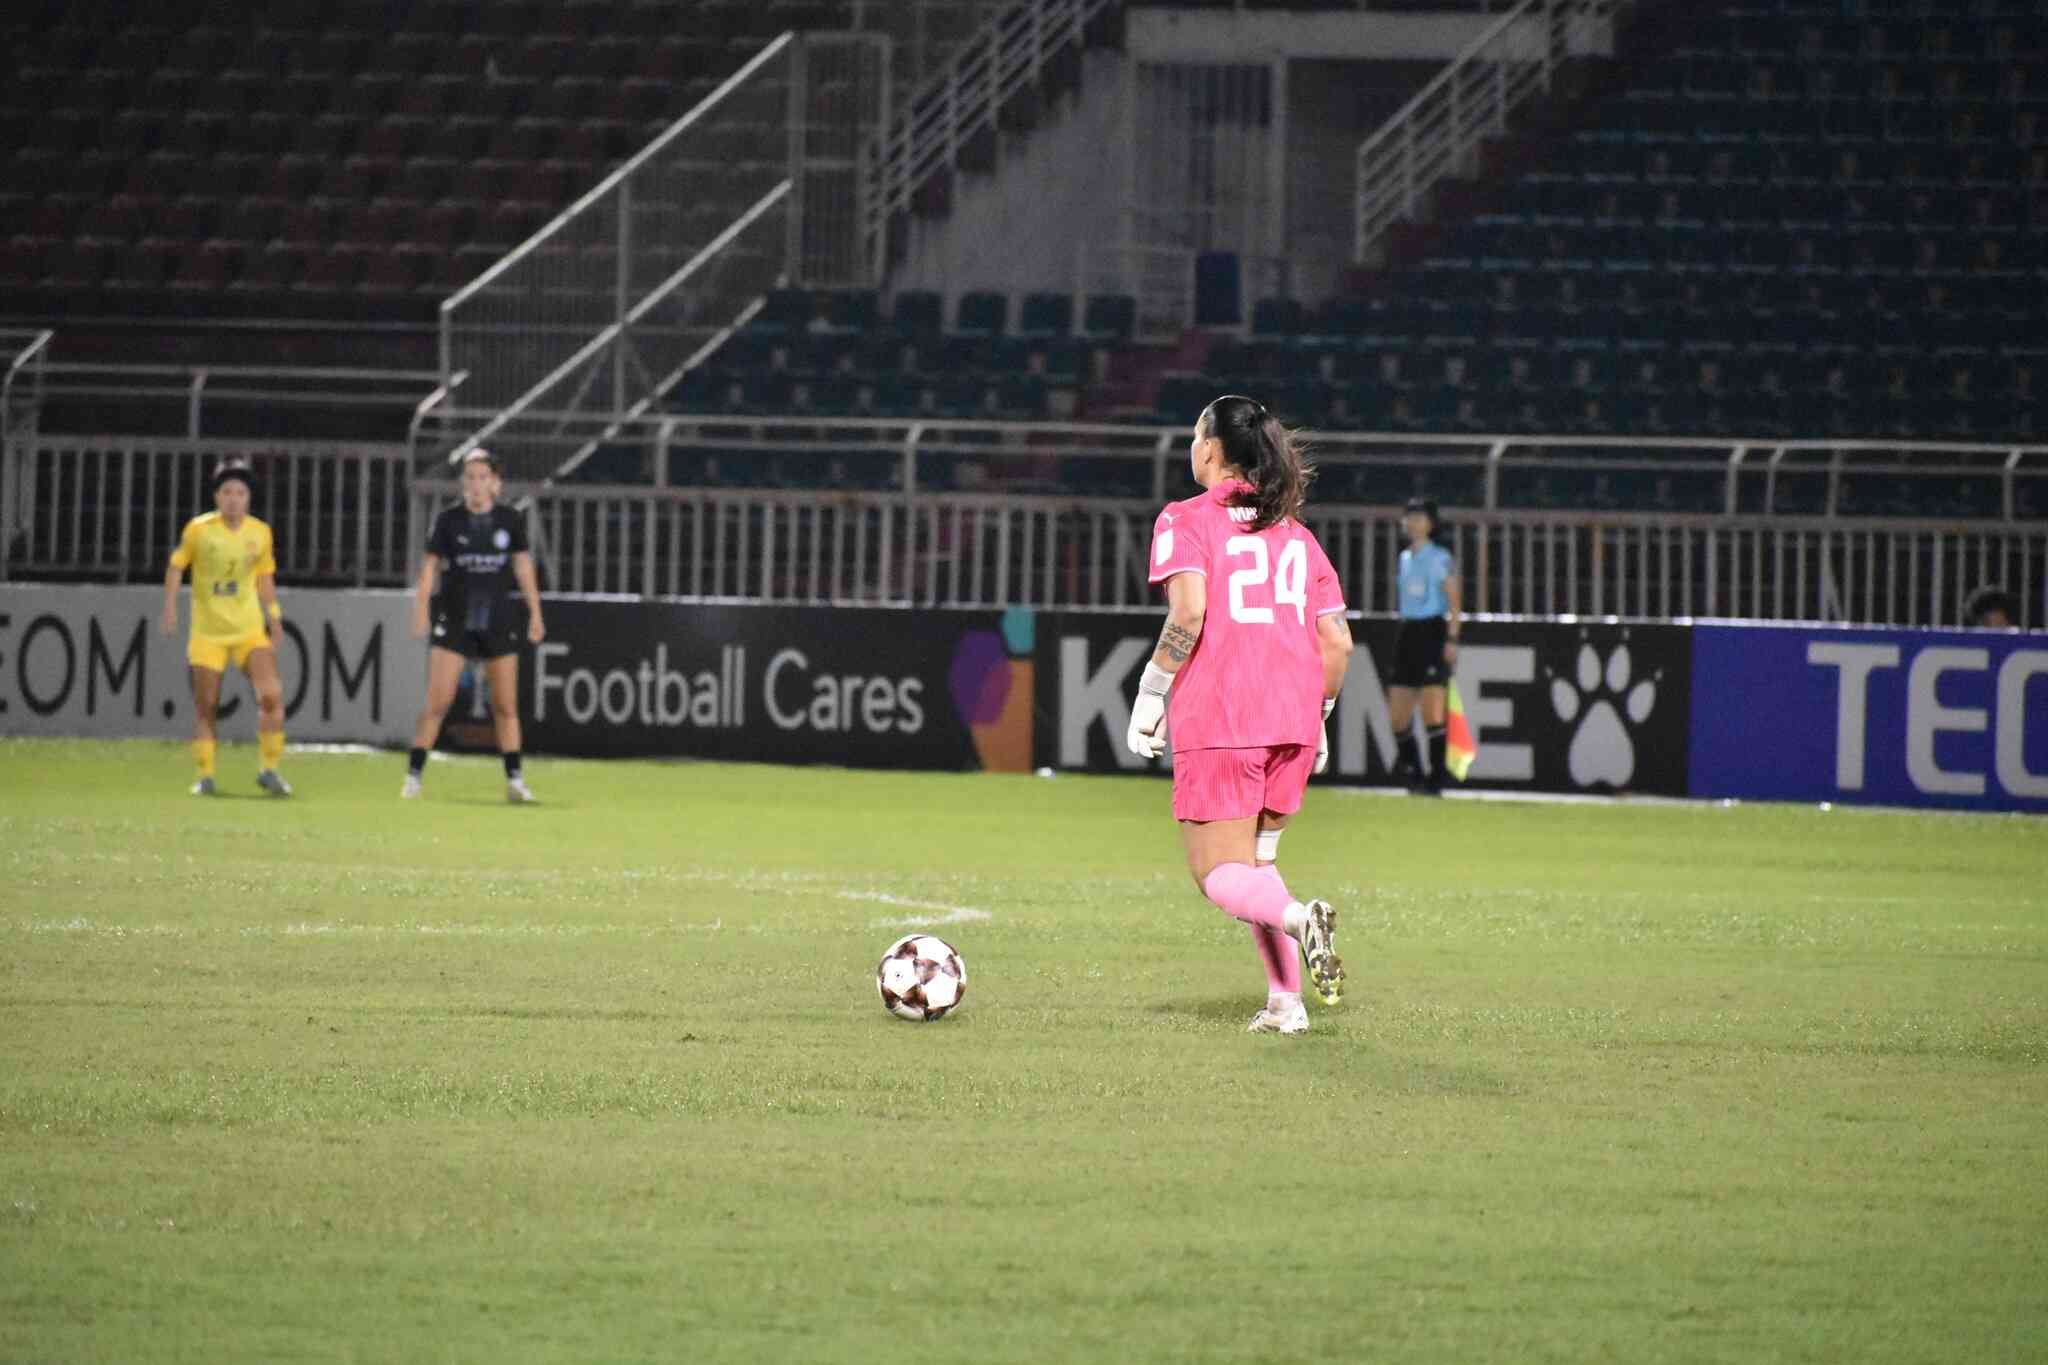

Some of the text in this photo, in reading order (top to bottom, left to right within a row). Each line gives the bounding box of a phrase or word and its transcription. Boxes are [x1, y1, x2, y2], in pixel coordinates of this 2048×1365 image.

[1226, 535, 1307, 626] 24
[534, 642, 923, 734] Football Cares
[1060, 636, 1535, 781] KME
